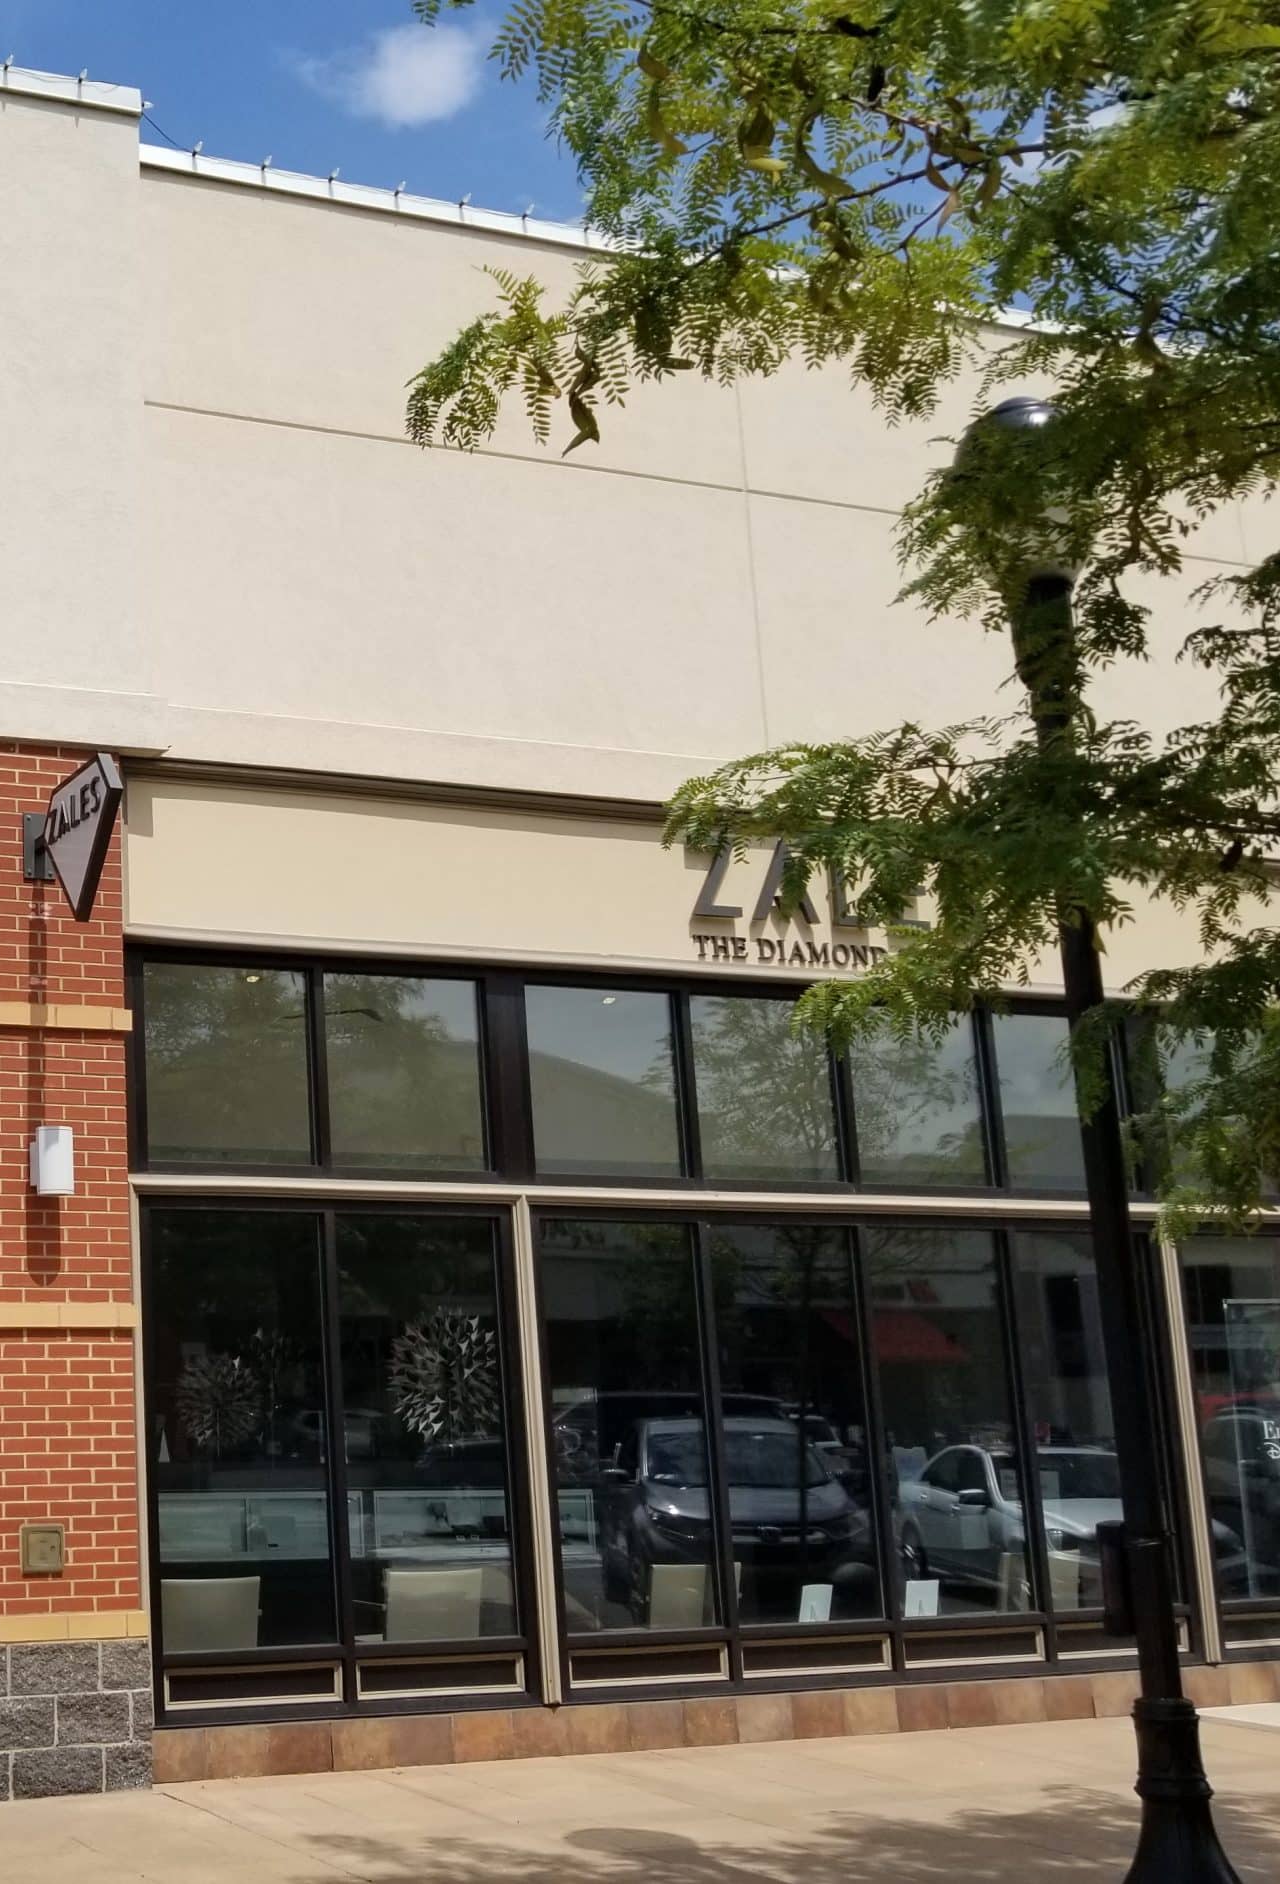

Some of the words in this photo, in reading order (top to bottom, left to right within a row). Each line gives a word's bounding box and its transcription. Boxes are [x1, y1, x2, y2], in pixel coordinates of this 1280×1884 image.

[48, 776, 101, 845] ZALES
[688, 836, 932, 930] ZAL
[693, 935, 749, 958] THE
